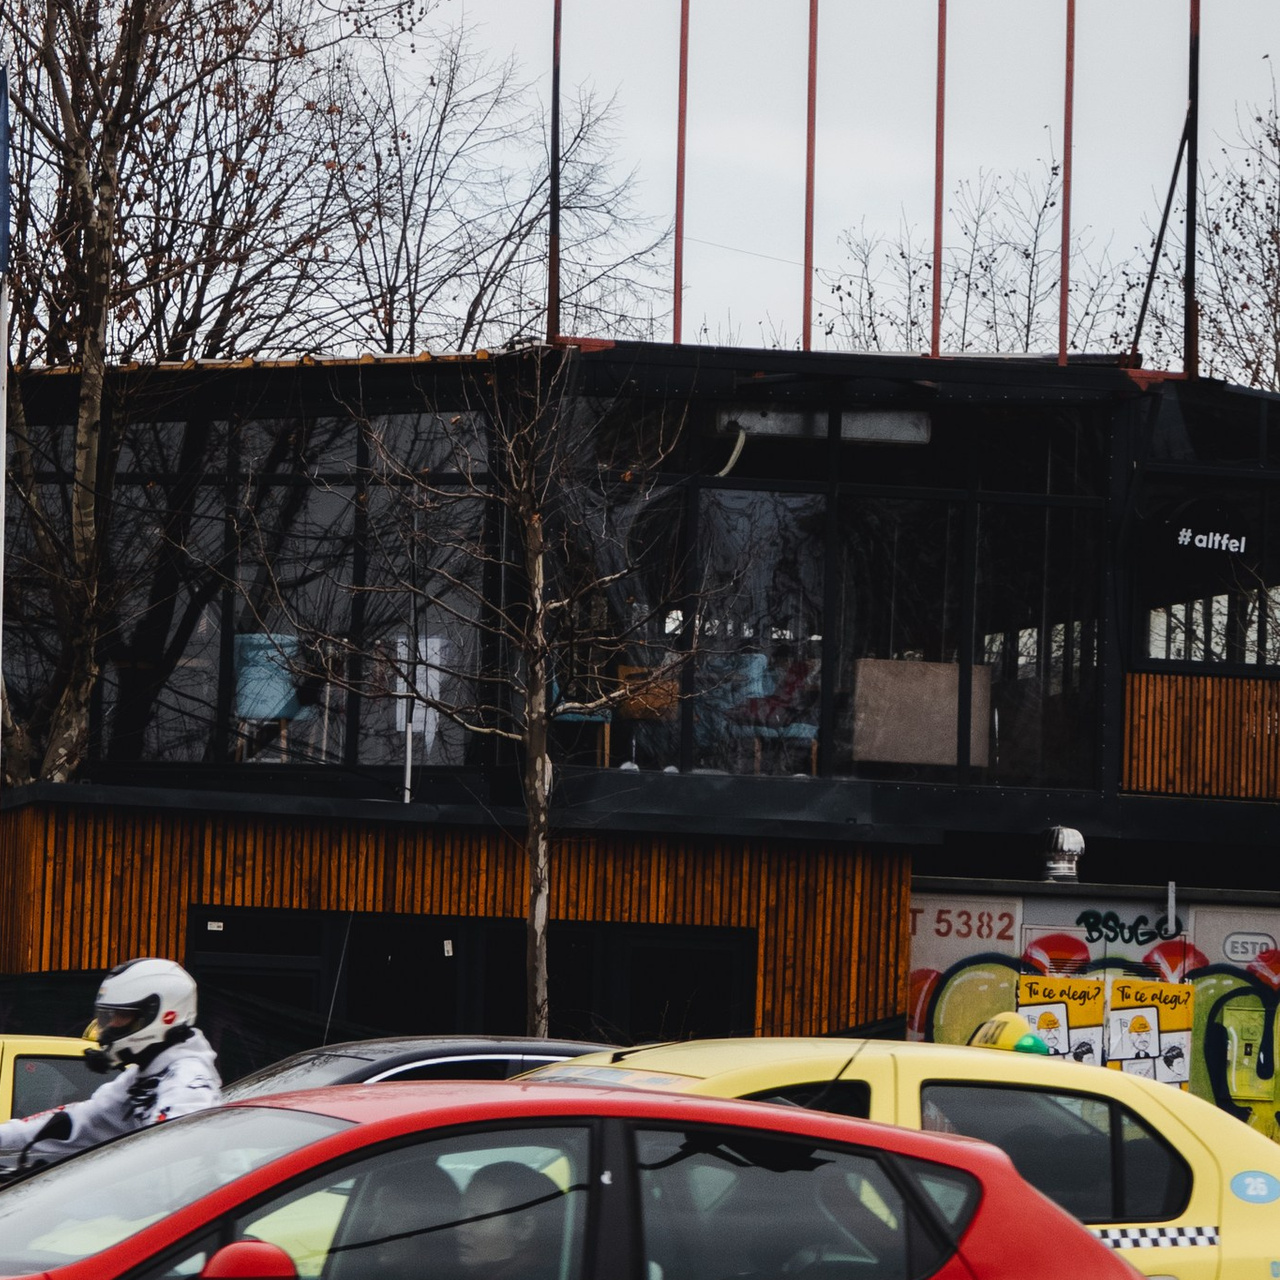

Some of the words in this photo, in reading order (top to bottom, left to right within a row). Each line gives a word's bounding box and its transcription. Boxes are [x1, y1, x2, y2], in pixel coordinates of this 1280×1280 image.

[934, 908, 1015, 941] 5382
[1024, 981, 1039, 998] Tu
[1042, 986, 1057, 1000] ce
[1059, 985, 1102, 1007] alegi?
[1116, 985, 1131, 1002] Tu
[1135, 989, 1148, 1003] ce
[1151, 989, 1191, 1011] alegi?
